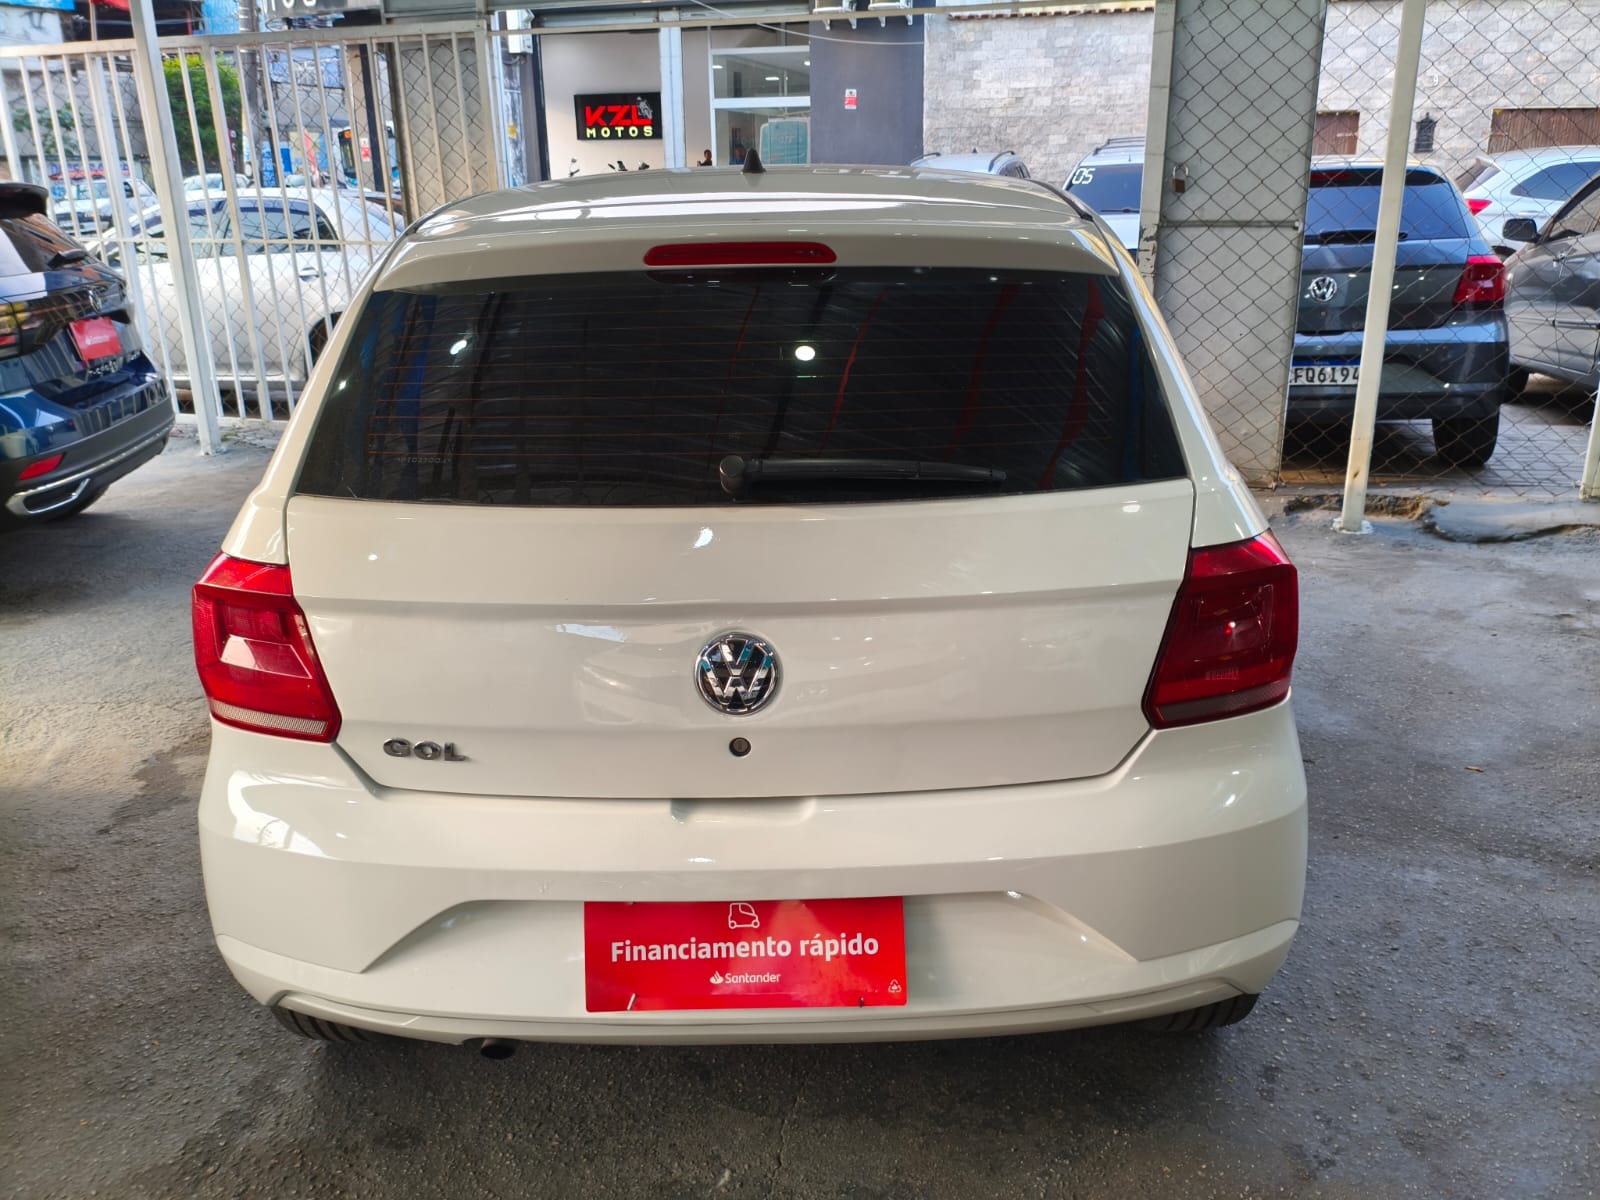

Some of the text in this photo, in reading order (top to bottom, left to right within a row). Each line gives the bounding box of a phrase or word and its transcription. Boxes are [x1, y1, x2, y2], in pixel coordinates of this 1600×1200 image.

[585, 105, 653, 127] KZL
[586, 125, 653, 138] MOTOS
[383, 738, 469, 762] GOL
[611, 932, 880, 962] Financiamento rápido
[725, 971, 781, 984] Santander
